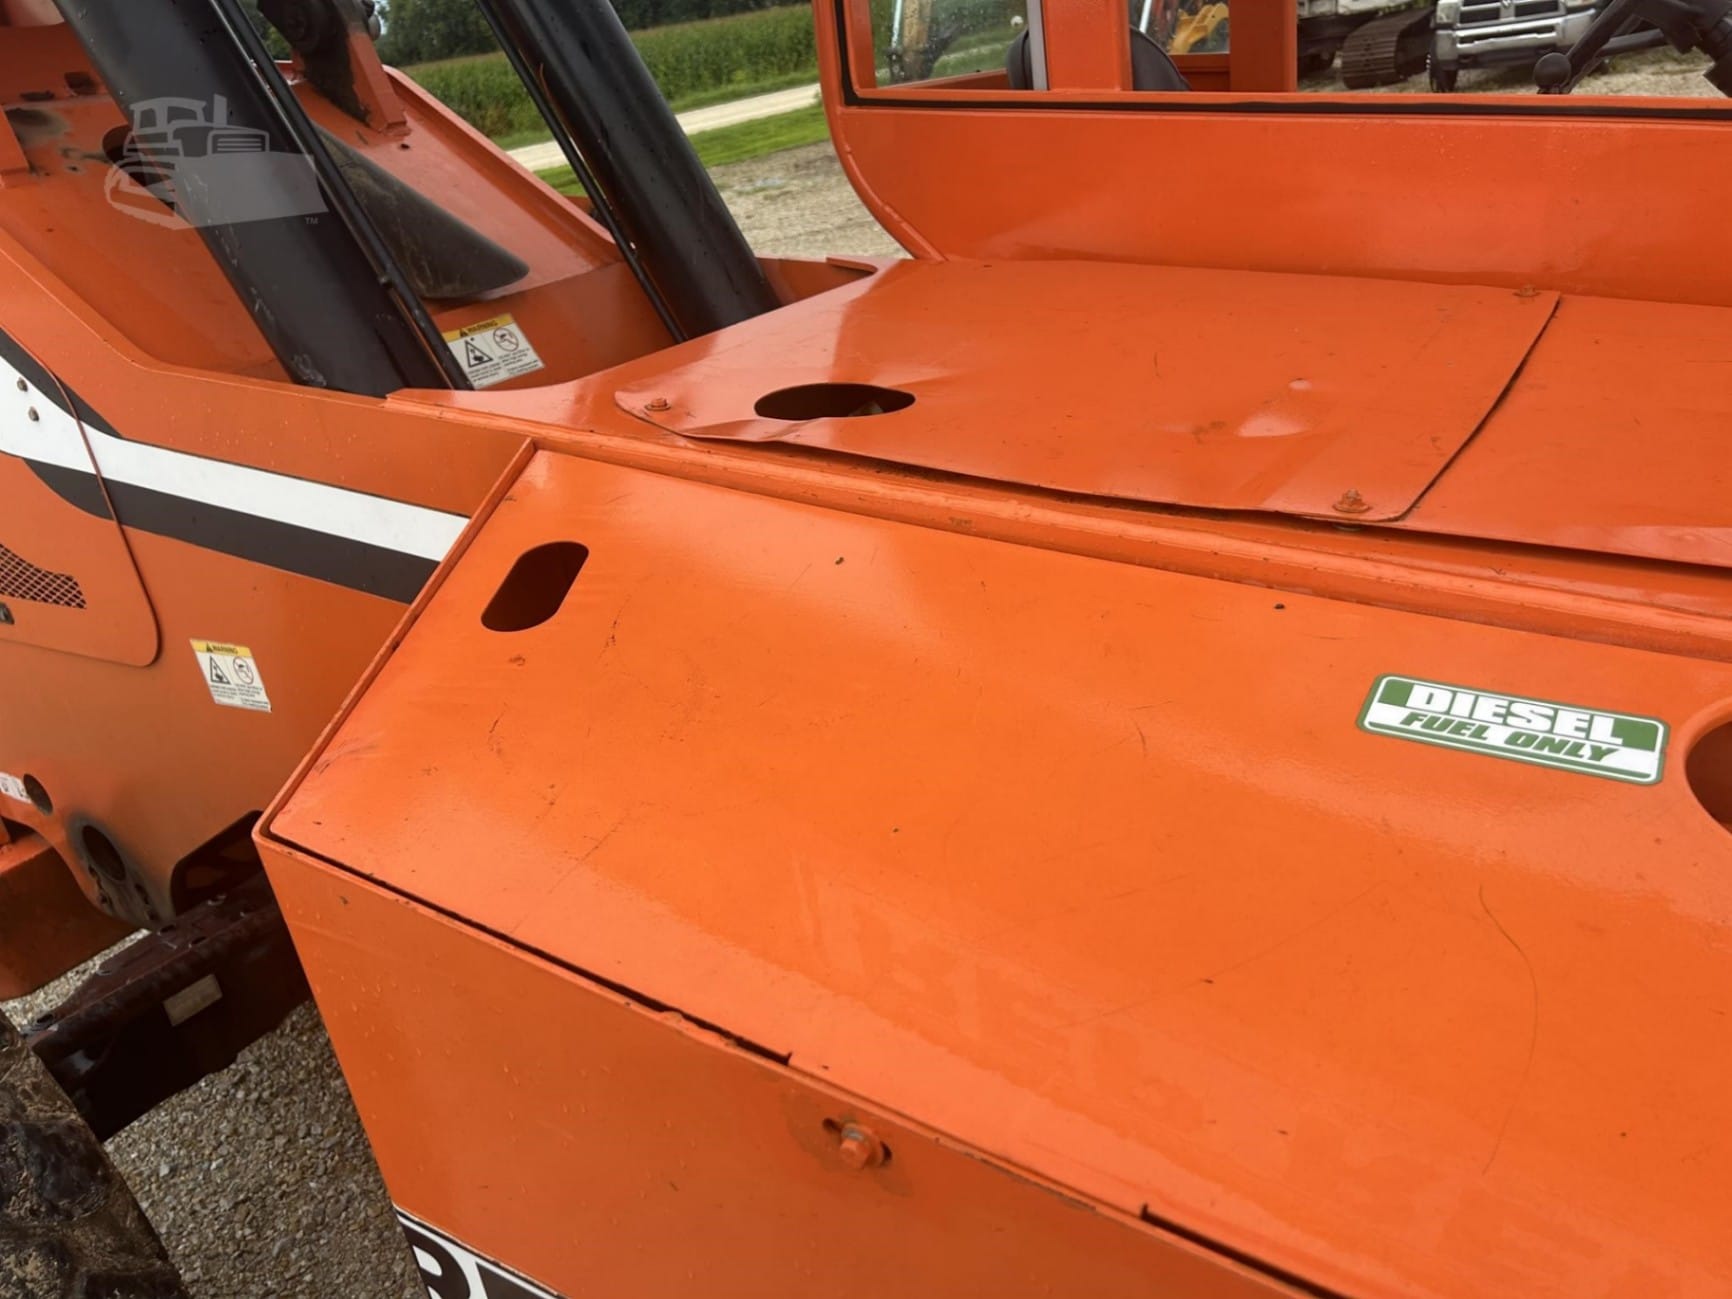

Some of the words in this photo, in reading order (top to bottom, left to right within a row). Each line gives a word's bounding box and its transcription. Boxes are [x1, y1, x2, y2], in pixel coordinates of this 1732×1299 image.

[1400, 711, 1489, 741] FUEL
[1504, 730, 1622, 763] ONLY
[1406, 683, 1623, 745] DIESEL
